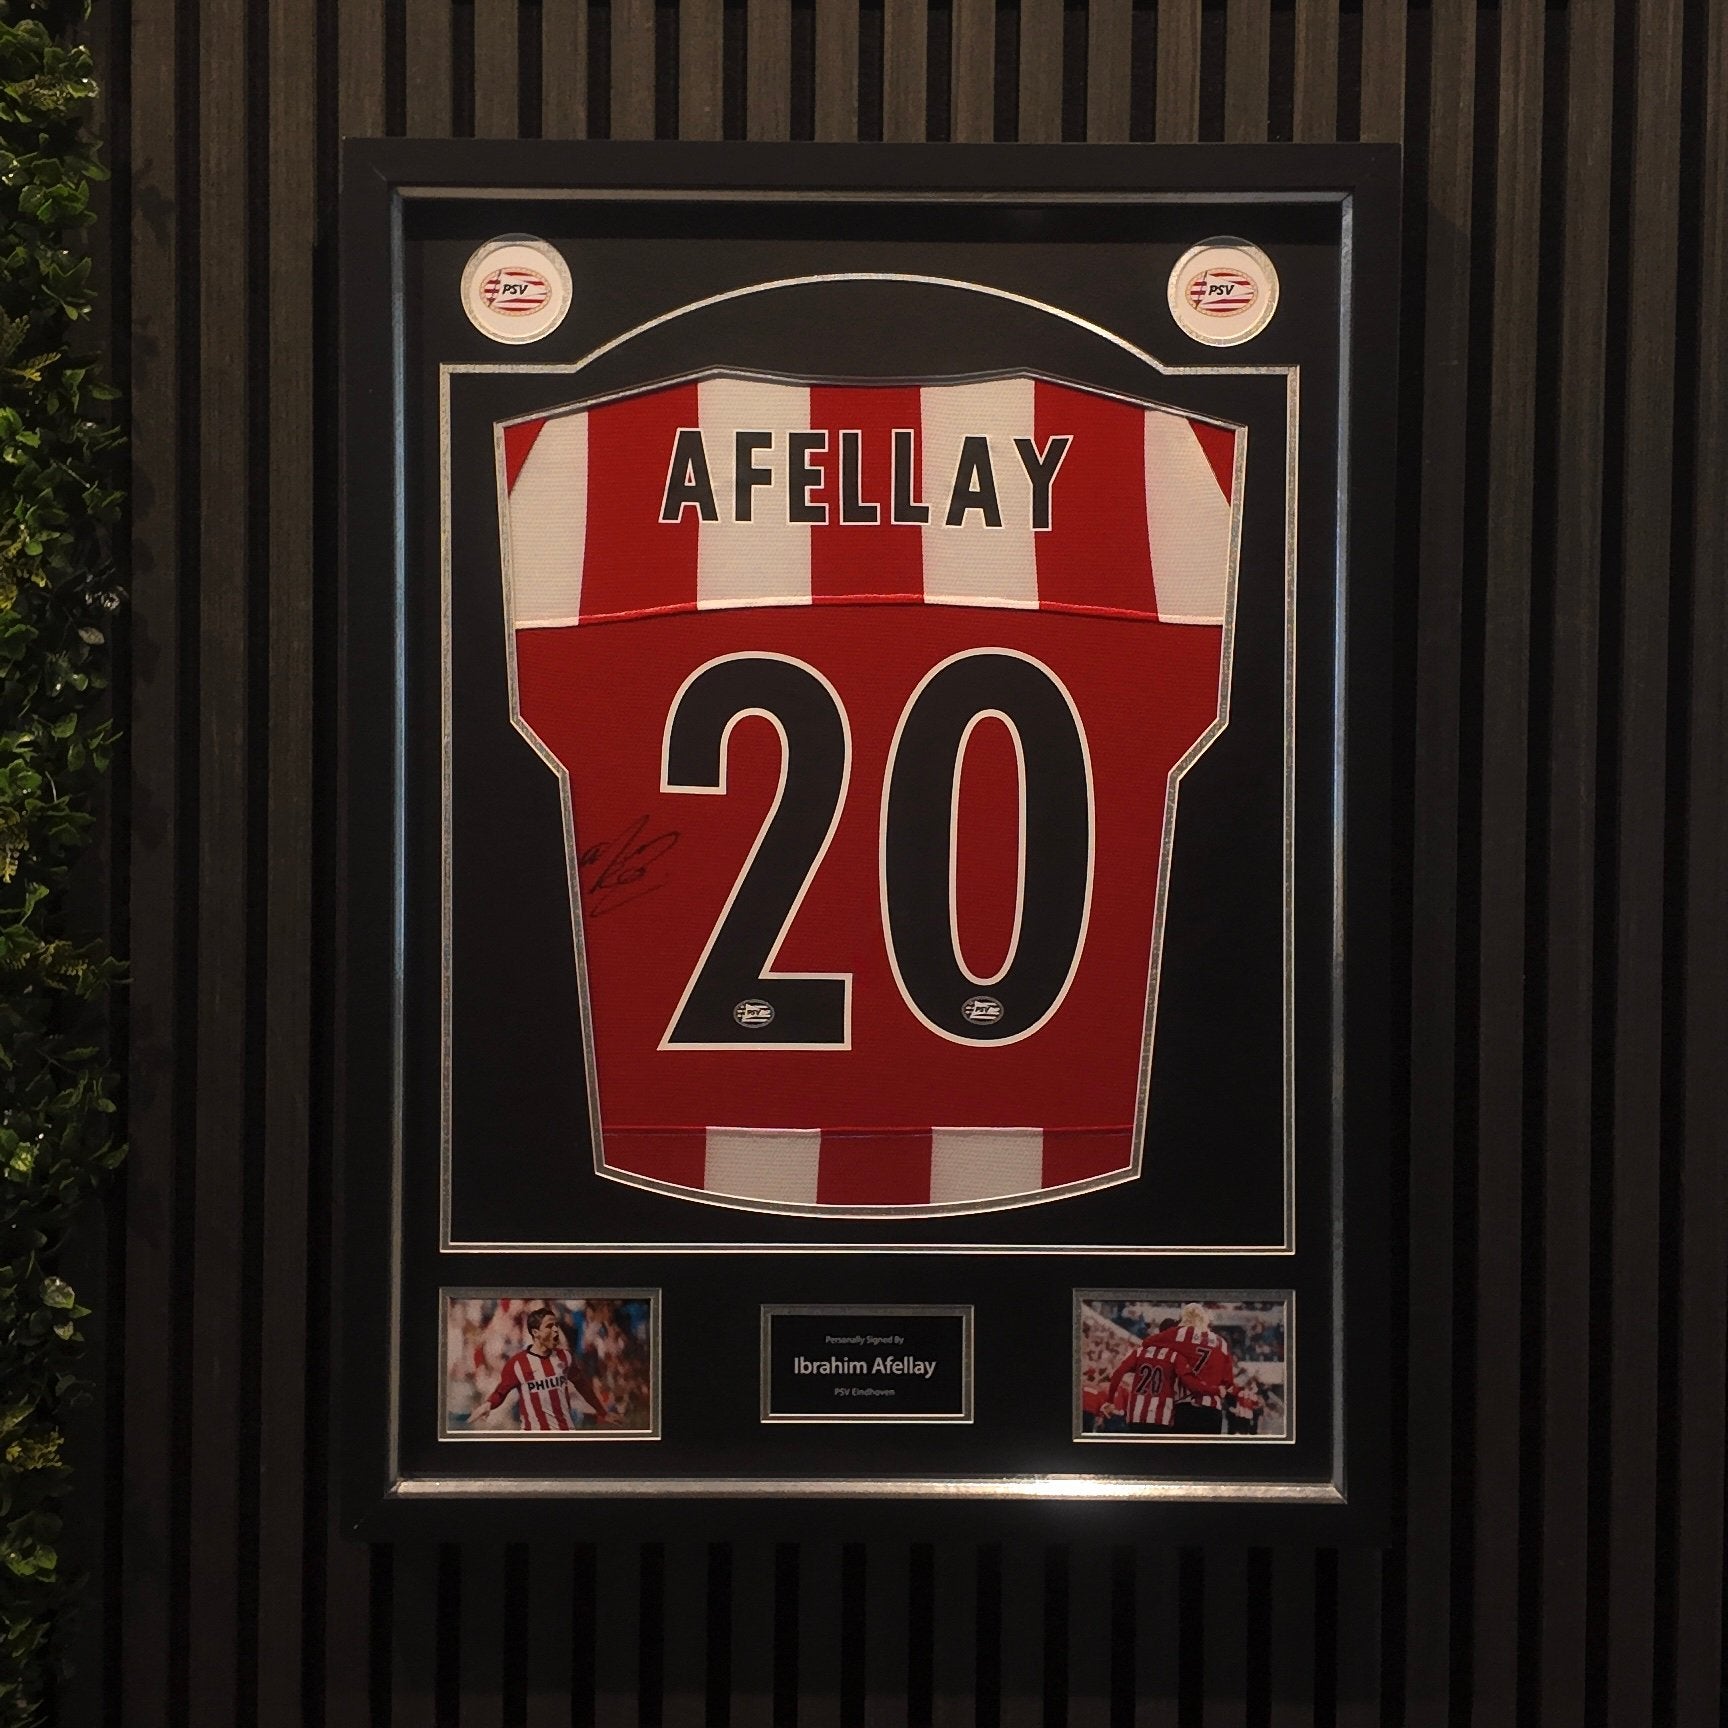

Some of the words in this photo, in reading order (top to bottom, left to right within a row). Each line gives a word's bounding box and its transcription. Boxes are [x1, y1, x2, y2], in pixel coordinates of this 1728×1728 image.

[502, 284, 529, 295] PSV
[1208, 284, 1235, 296] PSV
[657, 427, 1074, 532] AFELLAY
[656, 646, 1097, 1052] 20
[825, 1335, 865, 1346] Personally
[866, 1335, 893, 1346] Signed
[894, 1335, 905, 1345] By
[794, 1356, 867, 1375] Ibrahim
[871, 1355, 937, 1379] Afellay
[1192, 1346, 1212, 1377] 7
[1136, 1363, 1164, 1396] 20
[834, 1387, 850, 1396] PSV
[852, 1387, 896, 1397] Eindhoven
